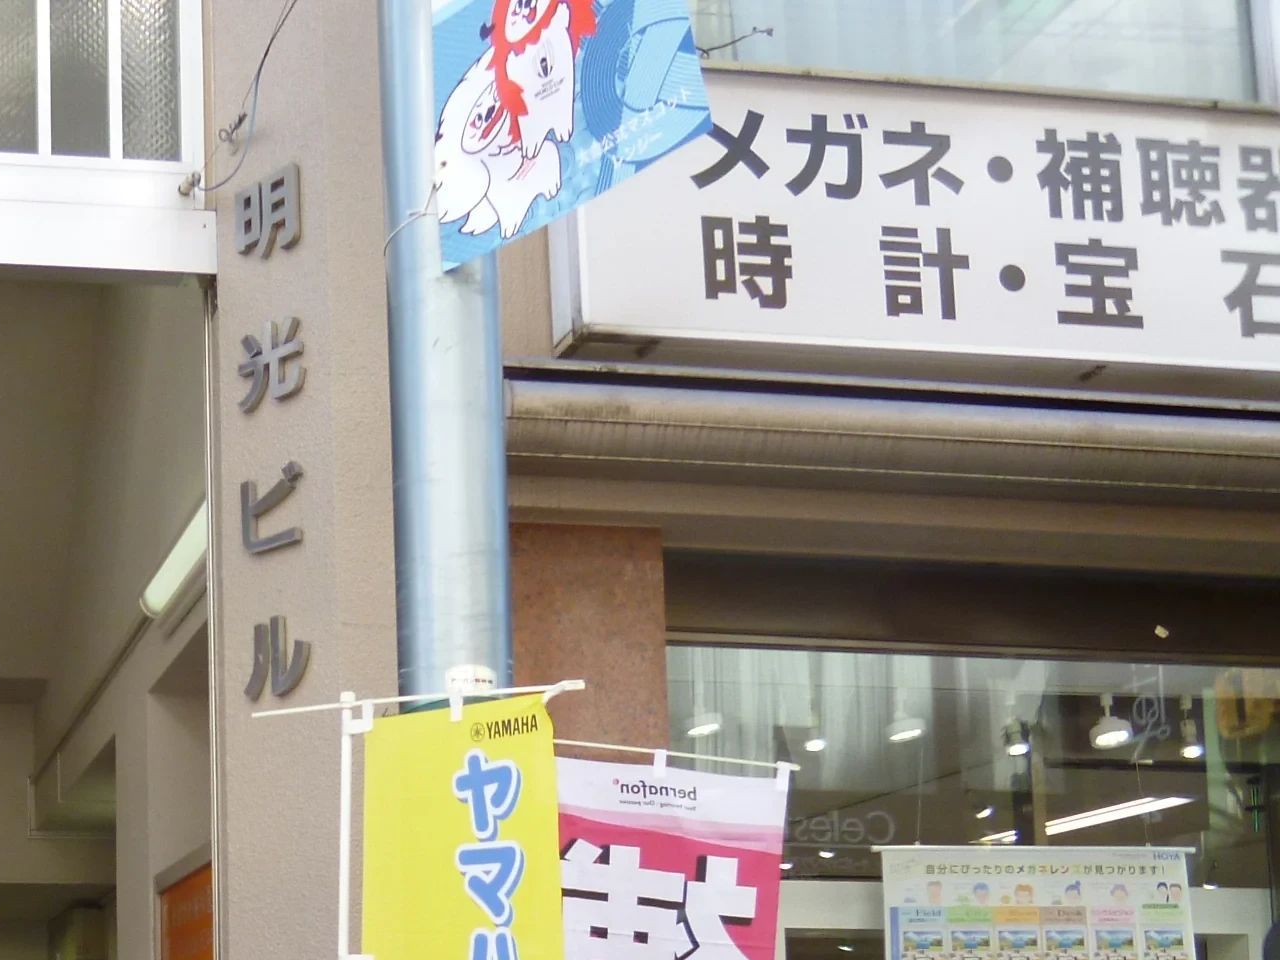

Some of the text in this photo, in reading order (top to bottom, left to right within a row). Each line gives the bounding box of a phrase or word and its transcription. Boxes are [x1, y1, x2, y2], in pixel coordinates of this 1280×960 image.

[235, 161, 311, 702] 明光ビル
[486, 714, 539, 740] YAMAHA
